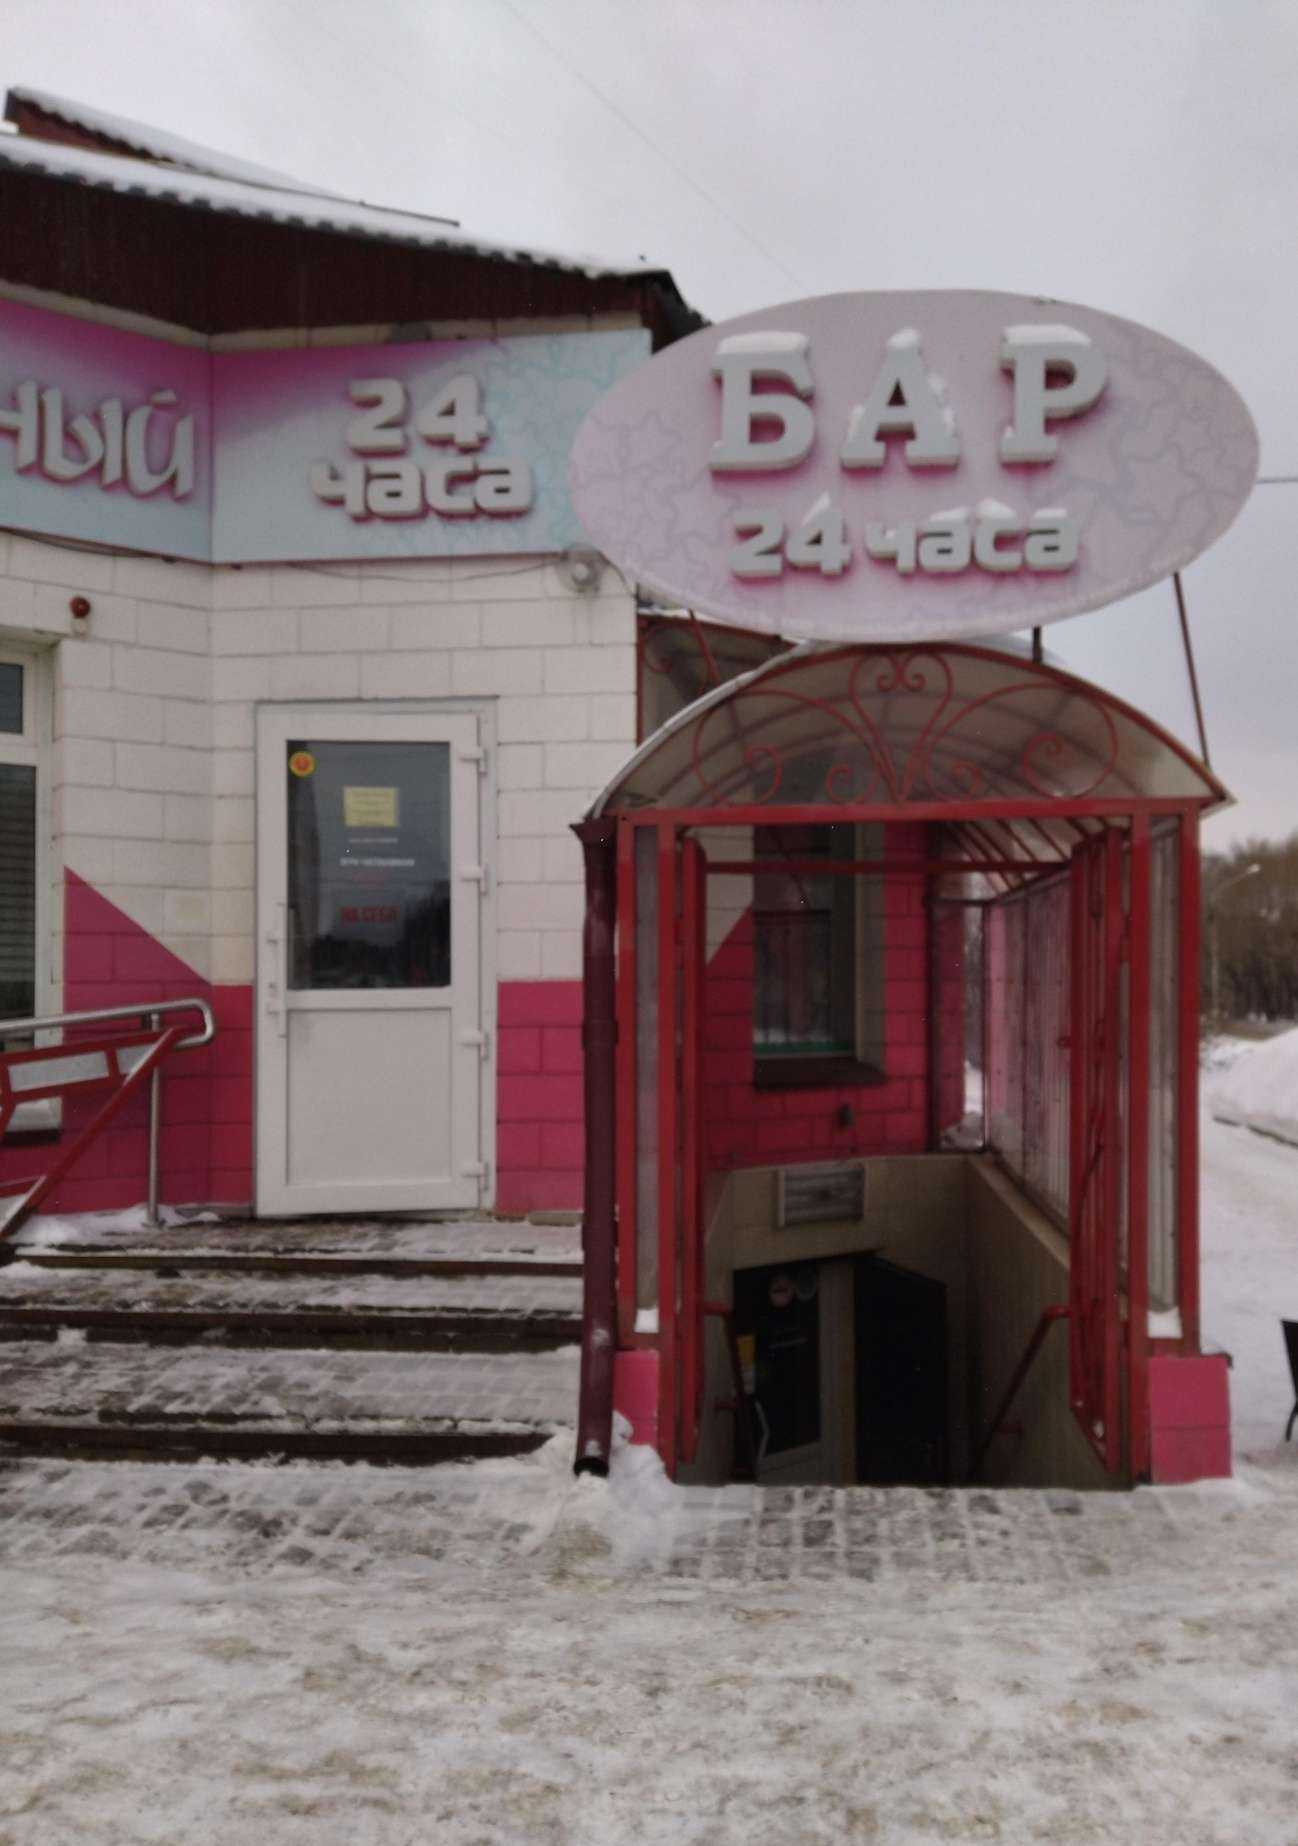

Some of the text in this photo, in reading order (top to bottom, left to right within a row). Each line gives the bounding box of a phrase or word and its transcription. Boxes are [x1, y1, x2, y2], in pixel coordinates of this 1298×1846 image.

[347, 374, 490, 455] 24
[708, 324, 1109, 473] БАР
[309, 455, 534, 522] часа
[729, 494, 1081, 577] 24 часа
